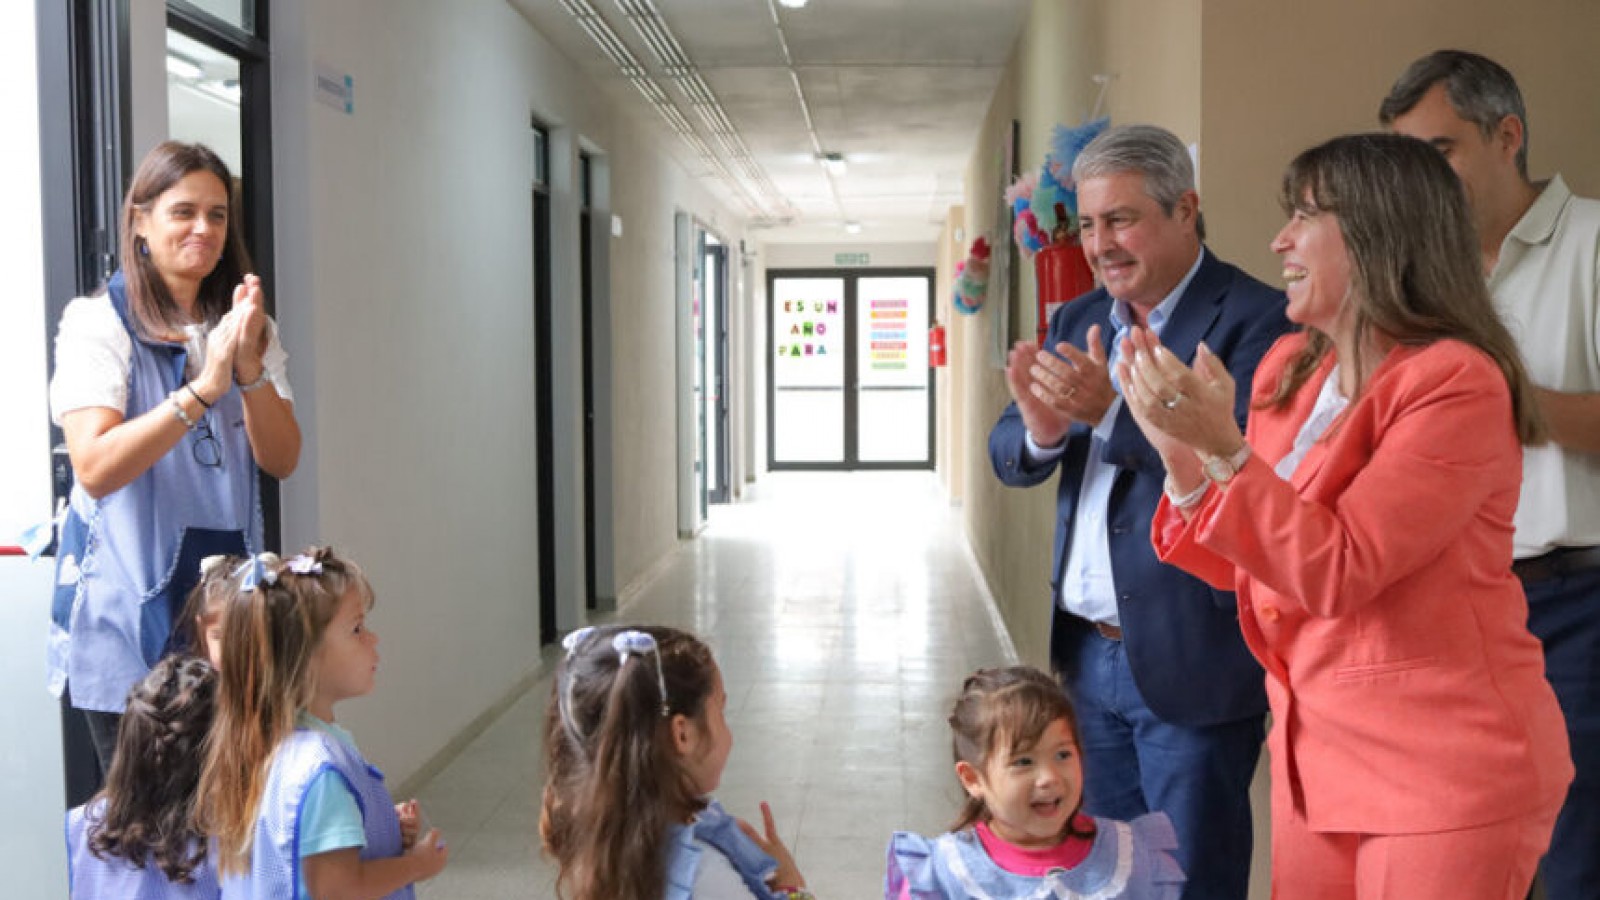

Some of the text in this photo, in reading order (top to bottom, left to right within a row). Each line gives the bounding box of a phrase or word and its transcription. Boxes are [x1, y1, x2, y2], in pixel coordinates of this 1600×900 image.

[784, 300, 838, 314] ES UN
[778, 344, 827, 357] PARA
